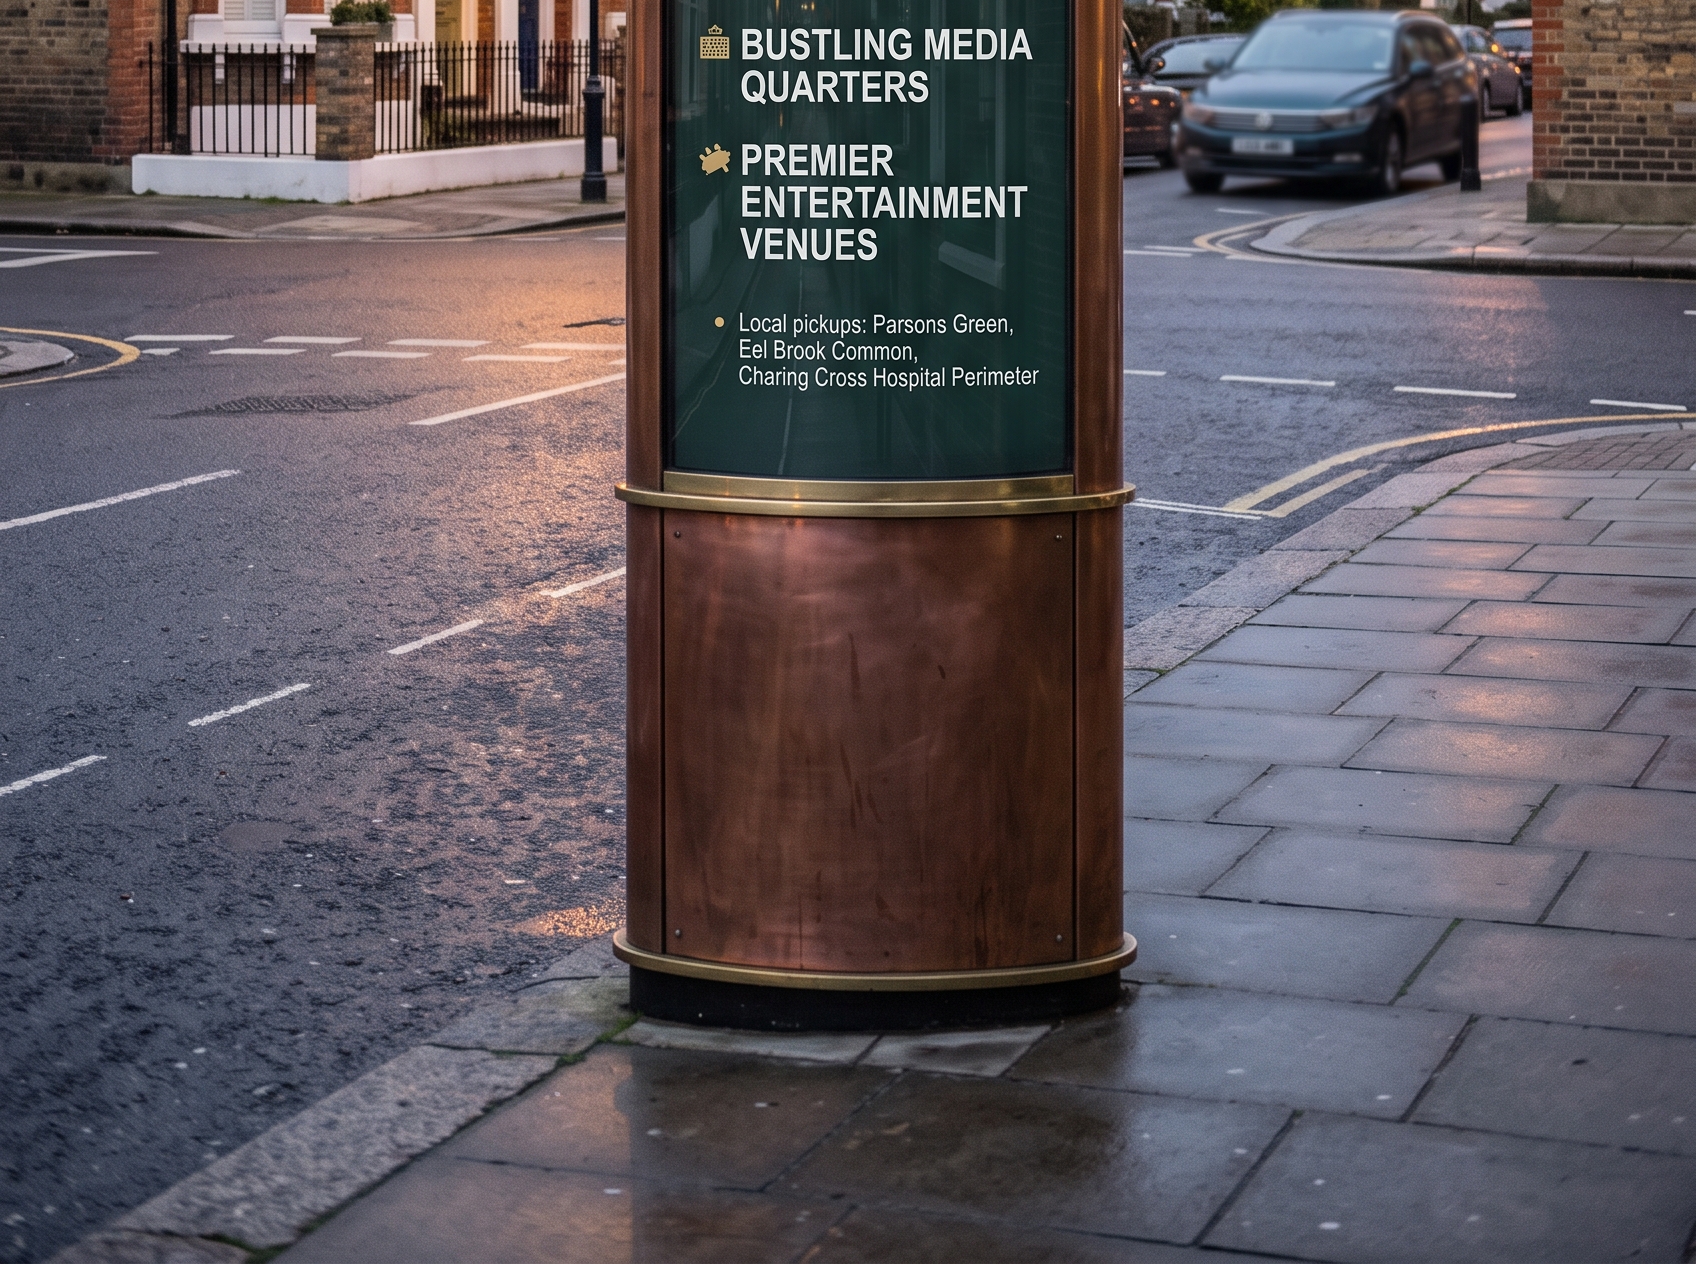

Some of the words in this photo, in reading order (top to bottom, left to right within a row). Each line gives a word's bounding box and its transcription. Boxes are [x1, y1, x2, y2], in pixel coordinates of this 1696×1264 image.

[741, 28, 913, 60] BUSTLING
[924, 29, 1033, 60] MEDIA
[741, 70, 929, 105] QUARTERS
[741, 144, 894, 176] PREMIER
[741, 186, 1028, 219] ENTERTAINMENT
[740, 227, 878, 261] VENUES
[739, 312, 786, 333] Local
[793, 314, 867, 338] pickups:
[873, 314, 946, 334] Parsons
[953, 314, 1014, 336] Green,
[739, 339, 767, 358] Eel
[774, 340, 826, 360] Brook
[832, 341, 918, 363] Common,
[738, 366, 808, 391] Charing
[814, 367, 867, 386] Cross
[873, 367, 946, 392] Hospital
[952, 366, 1039, 386] Perimeter
